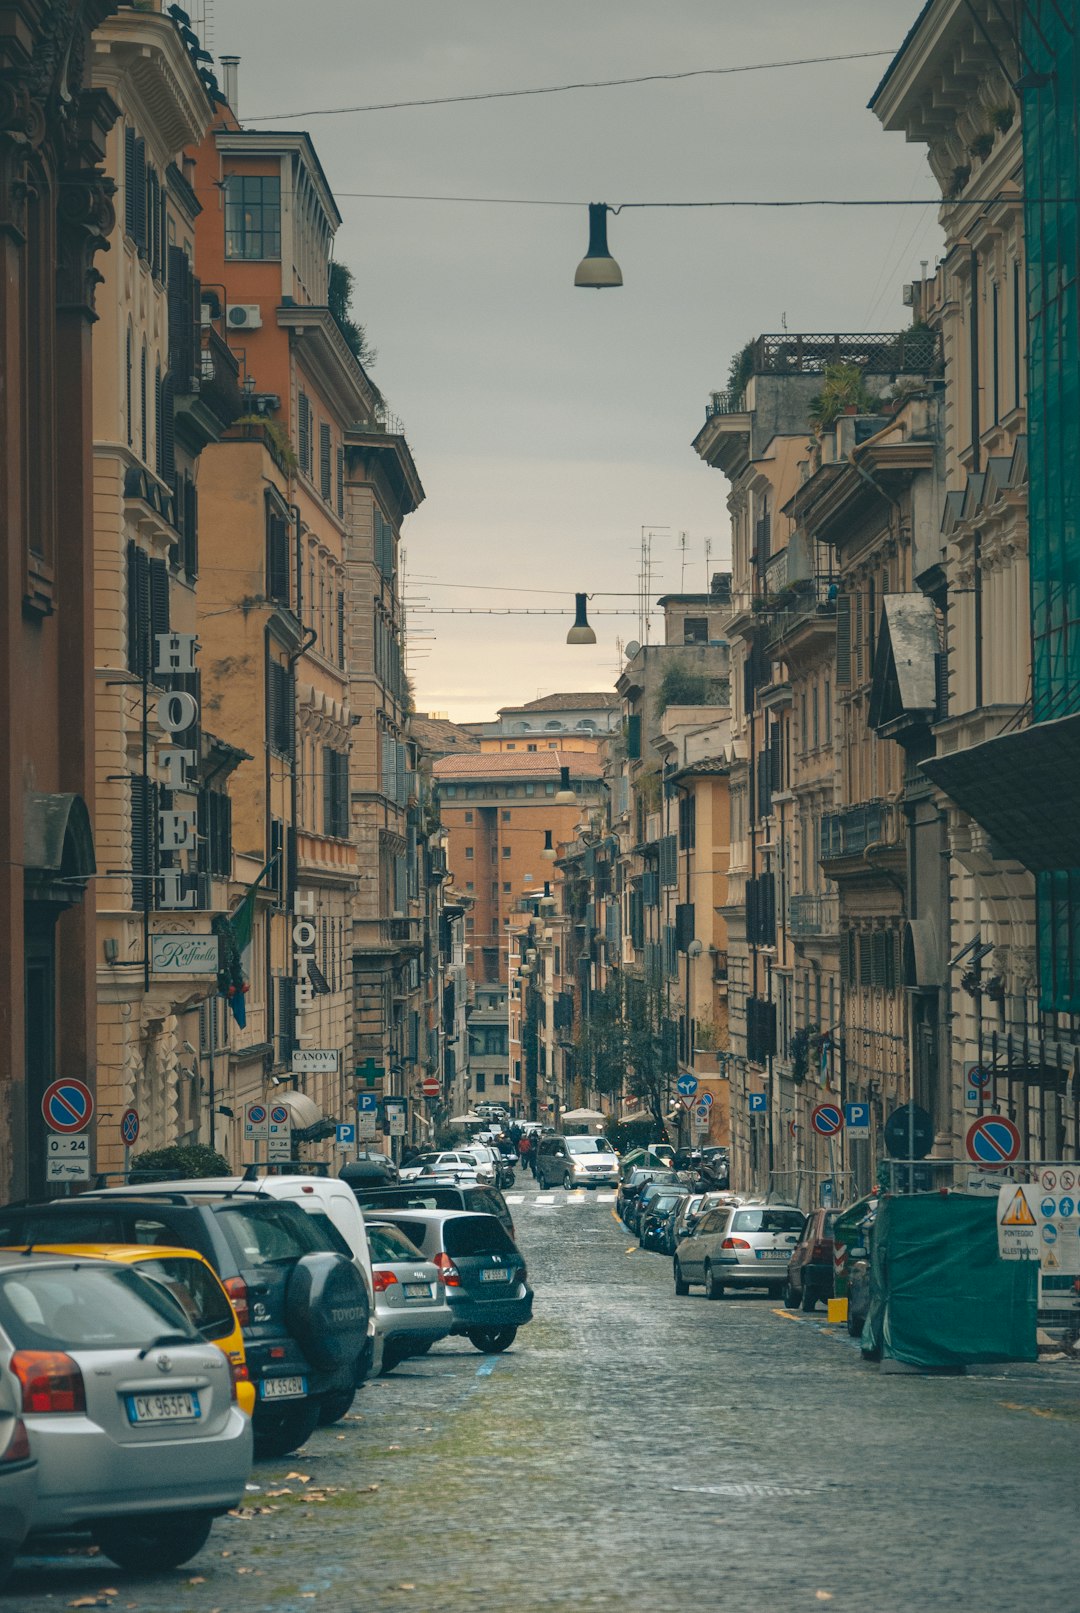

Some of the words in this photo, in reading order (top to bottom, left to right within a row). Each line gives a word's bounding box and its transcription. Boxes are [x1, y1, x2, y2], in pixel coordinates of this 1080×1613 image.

[154, 633, 199, 908] HOTEL
[154, 941, 216, 967] Raffaello
[292, 891, 316, 1040] HOTEL
[362, 1096, 371, 1109] P
[752, 1096, 762, 1109] P
[851, 1106, 863, 1123] P
[339, 1126, 351, 1140] P
[51, 1141, 59, 1151] 0
[70, 1141, 86, 1151] 24
[332, 1307, 364, 1321] TOYOTA
[265, 1380, 275, 1395] CX
[137, 1399, 152, 1417] CK
[155, 1395, 192, 1416] 963FW
